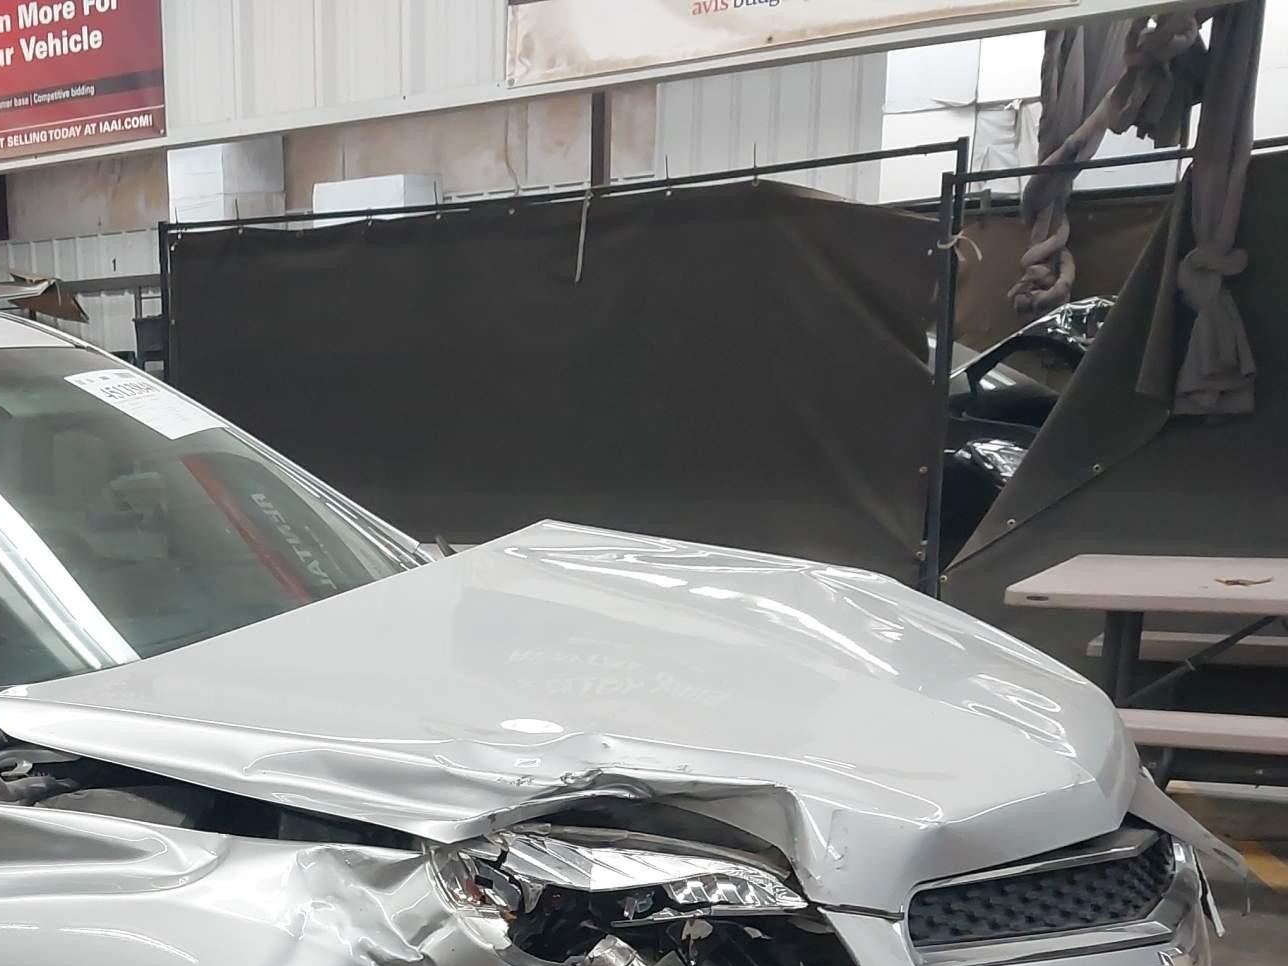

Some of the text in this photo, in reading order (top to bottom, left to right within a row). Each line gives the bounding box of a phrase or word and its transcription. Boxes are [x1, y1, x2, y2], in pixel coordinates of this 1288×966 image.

[17, 0, 75, 29] More
[20, 26, 103, 62] Vehicle
[13, 96, 29, 107] base
[33, 86, 70, 104] Competitive
[70, 84, 95, 96] bidding
[7, 130, 47, 147] SELLING
[48, 125, 82, 142] TODAY
[83, 122, 97, 136] AT
